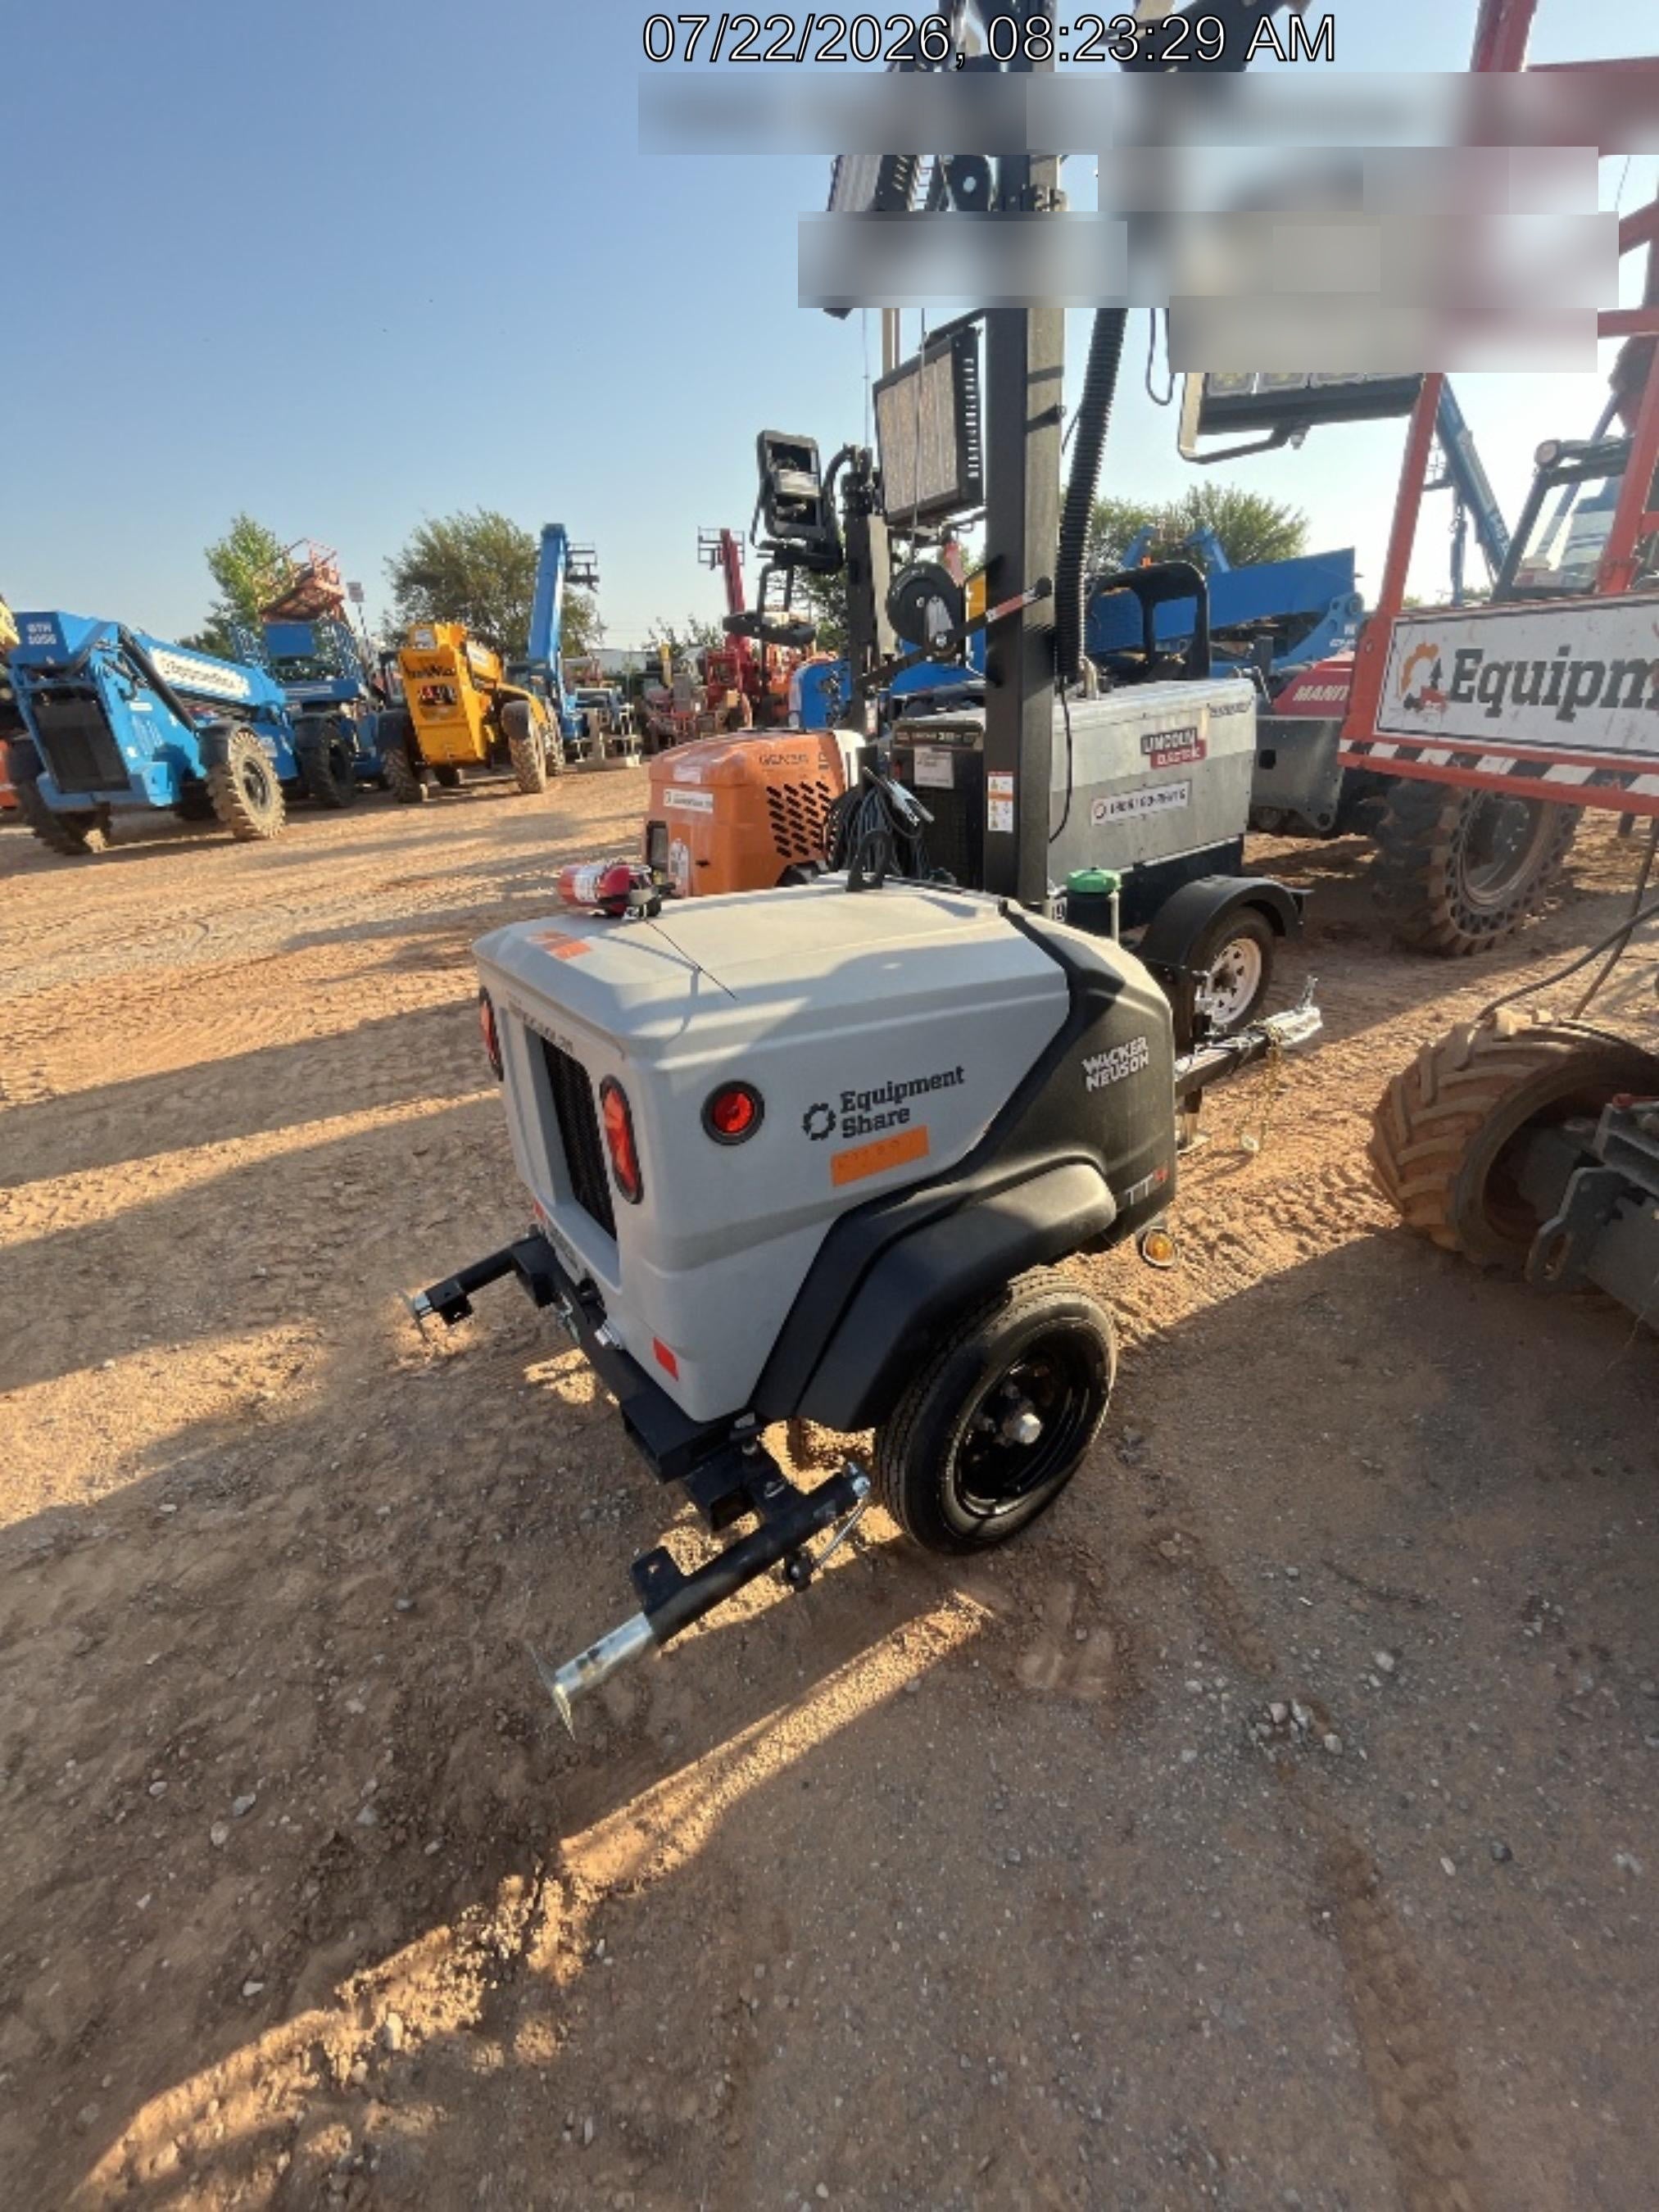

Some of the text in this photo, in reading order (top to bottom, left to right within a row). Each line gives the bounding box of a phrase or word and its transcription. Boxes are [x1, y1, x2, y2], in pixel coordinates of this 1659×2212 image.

[1081, 1036, 1149, 1075] WACKER
[1086, 1052, 1149, 1092] NEUSON
[840, 1066, 965, 1113] Equipment
[841, 1108, 911, 1139] Share
